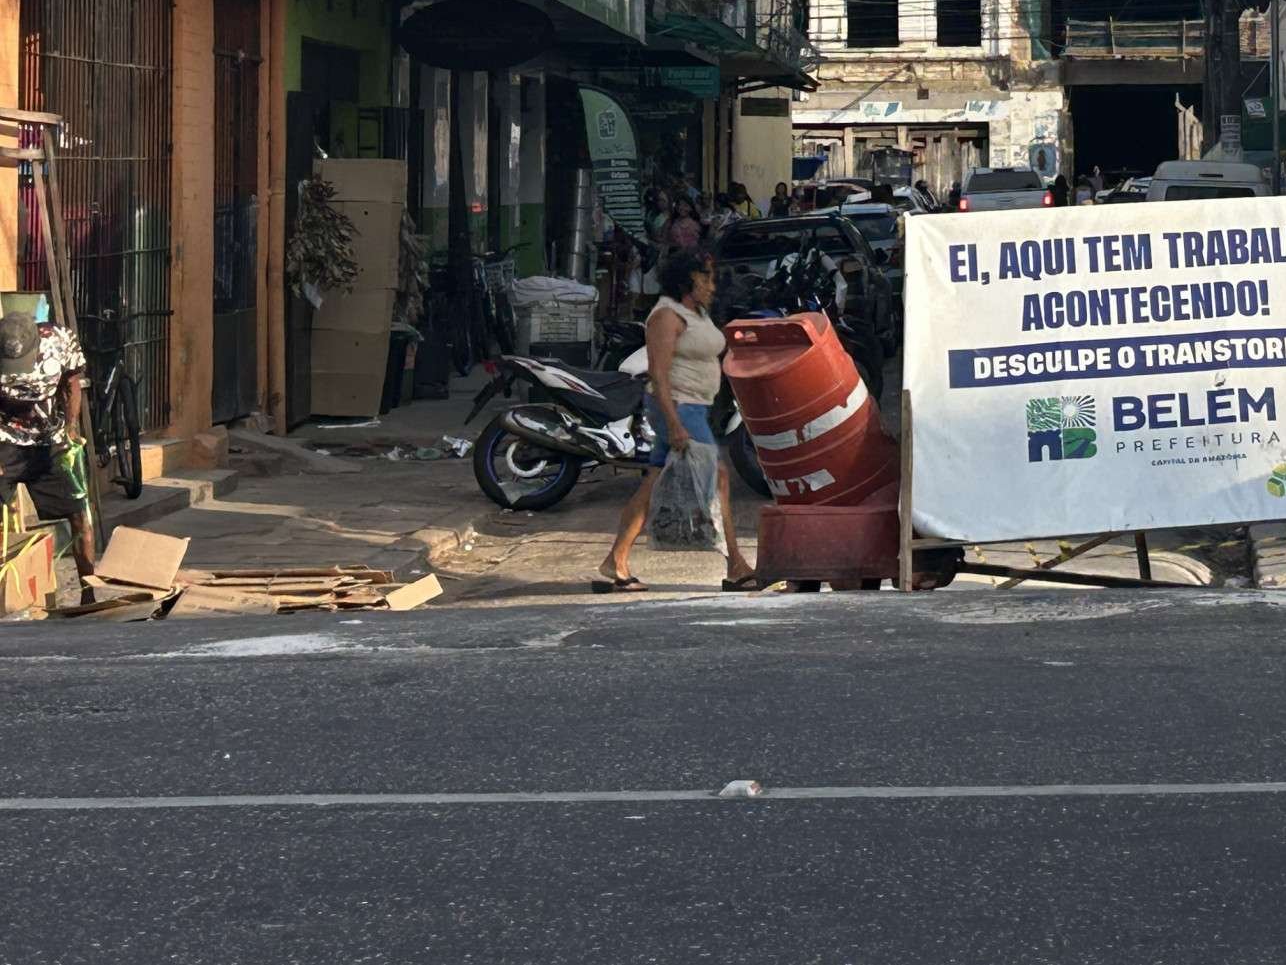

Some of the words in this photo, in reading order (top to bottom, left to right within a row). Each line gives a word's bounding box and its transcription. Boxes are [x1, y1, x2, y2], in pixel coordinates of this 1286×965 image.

[948, 243, 991, 286] EI,
[999, 237, 1077, 281] AQUI
[1083, 233, 1153, 273] TEM
[1021, 279, 1271, 332] ACONTECENDO!
[973, 346, 1112, 380] DESCULPE
[1116, 345, 1136, 370] O
[1111, 378, 1277, 432] BELÉM
[1116, 430, 1281, 453] PREFEITURA
